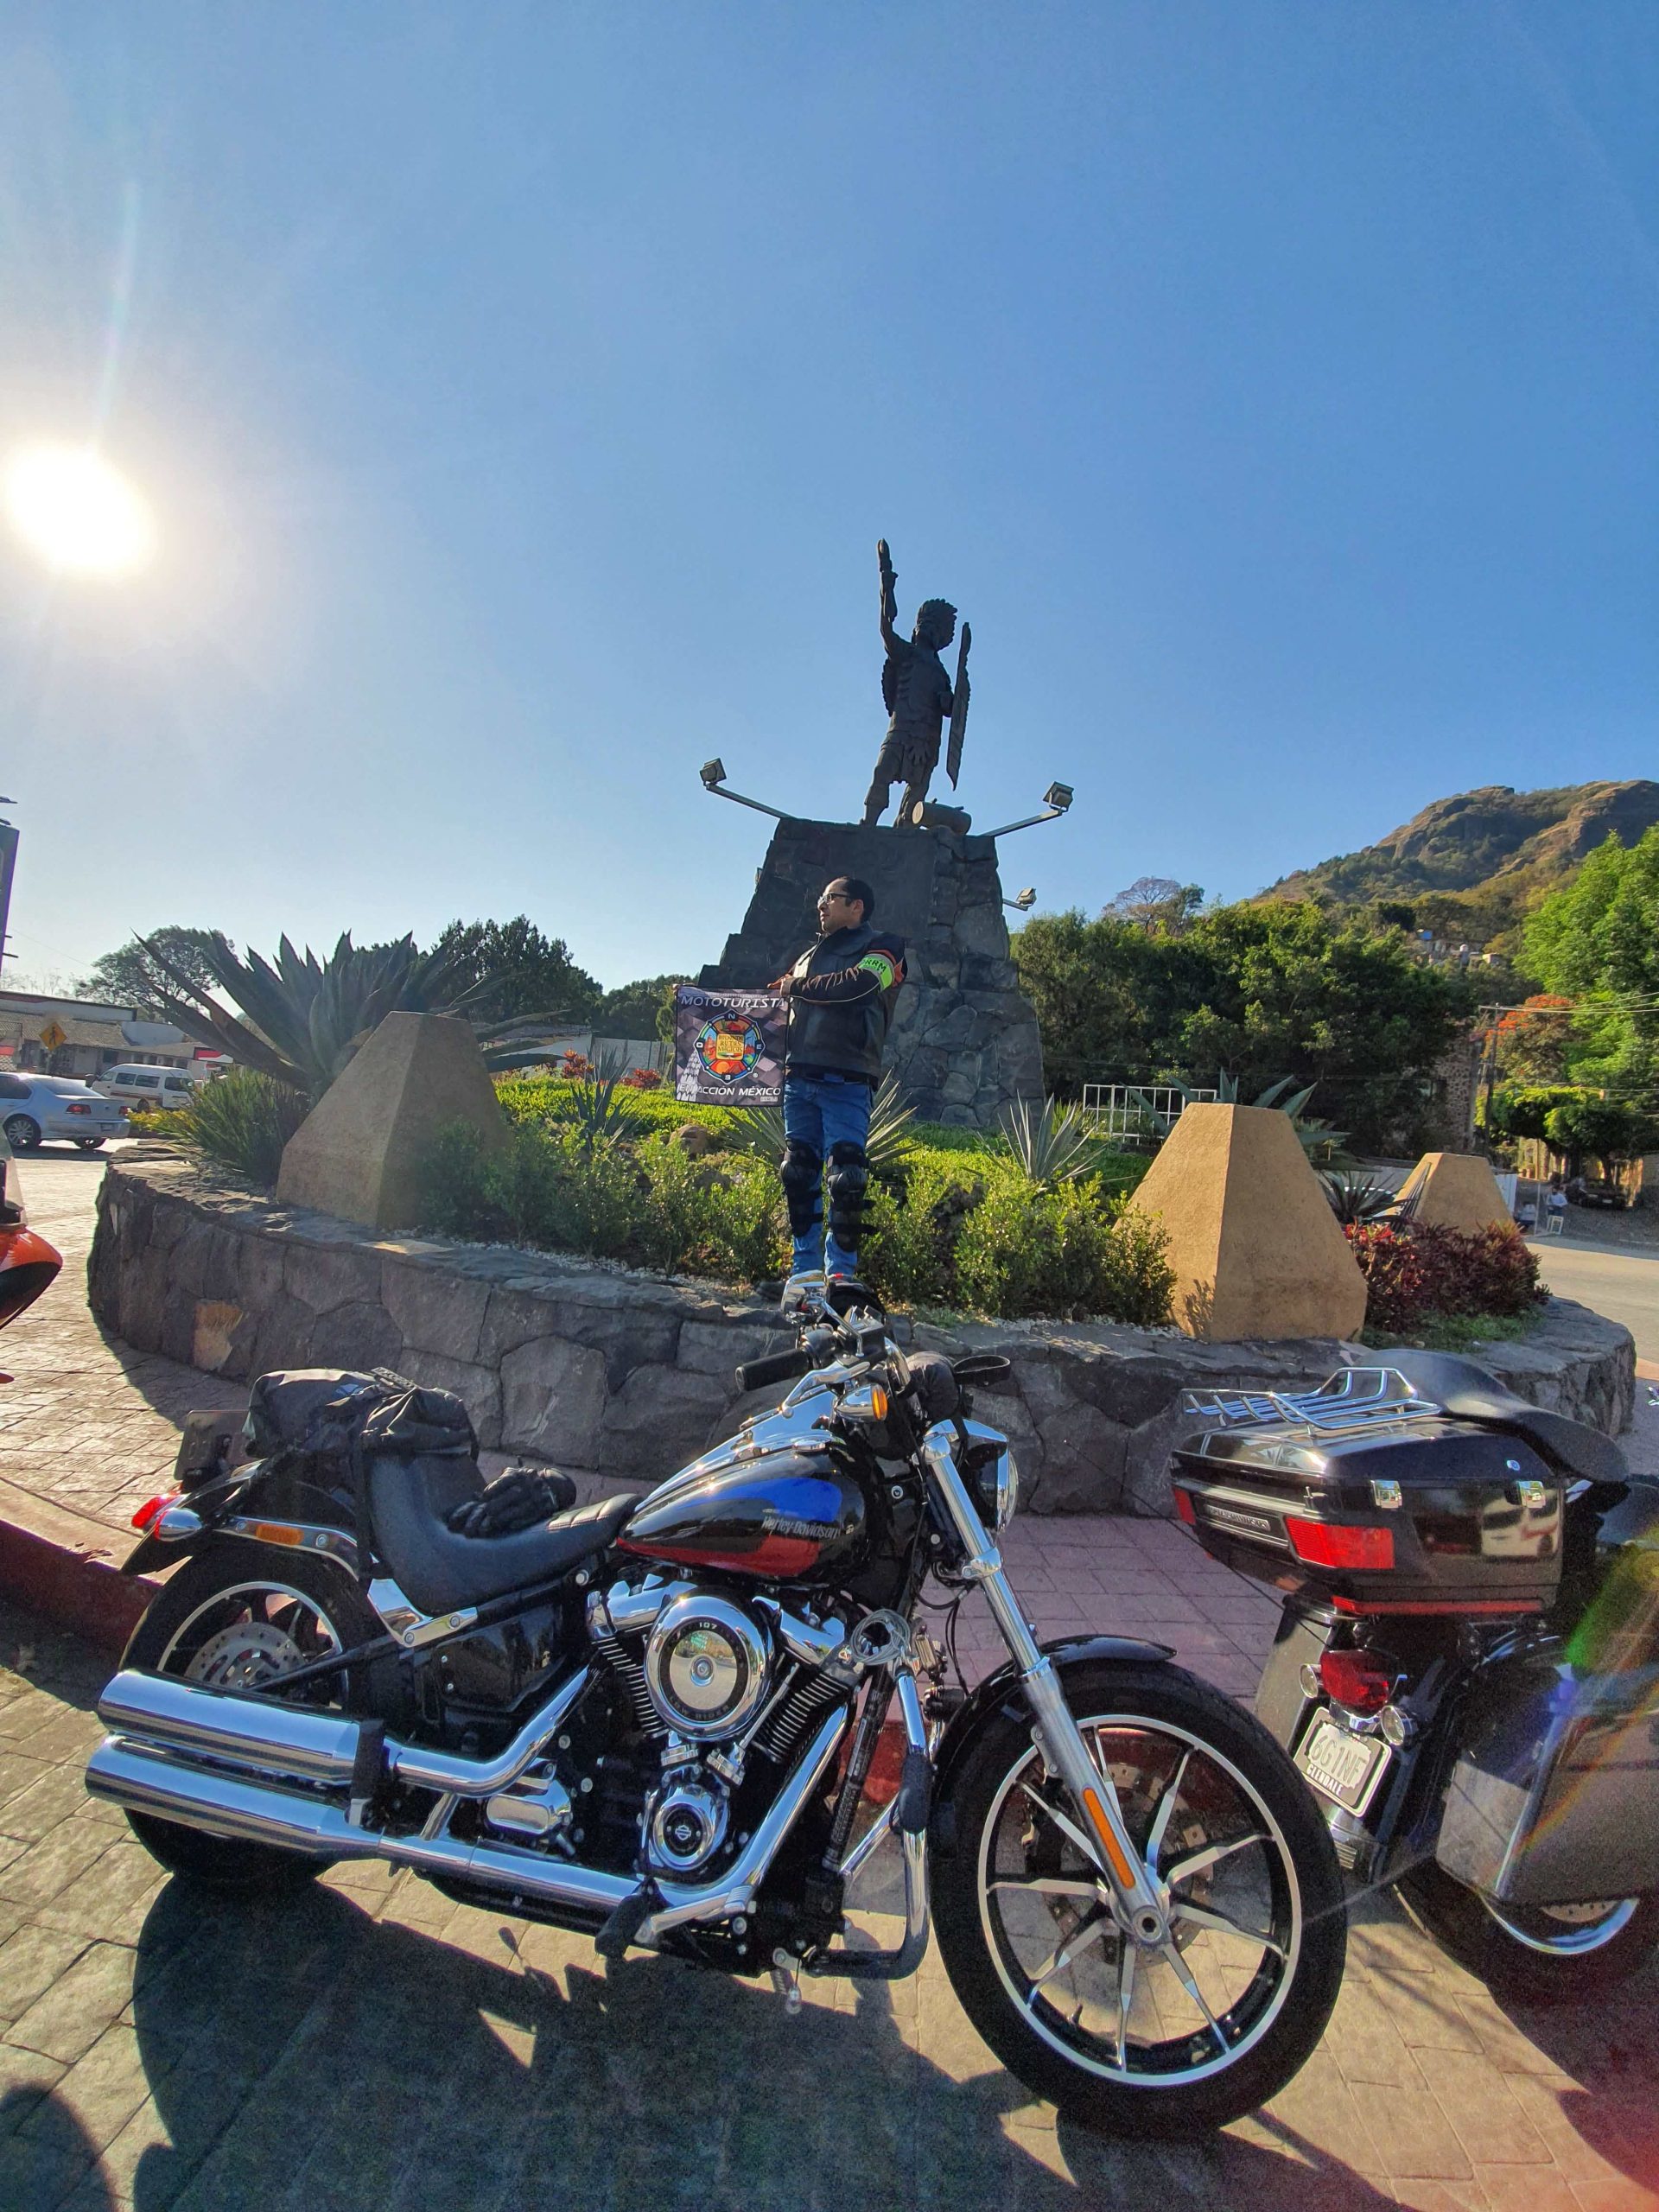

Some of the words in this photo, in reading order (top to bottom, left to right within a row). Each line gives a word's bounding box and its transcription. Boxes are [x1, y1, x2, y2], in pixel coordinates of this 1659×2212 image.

[681, 995, 785, 1009] MOTOTURISTA
[698, 1085, 735, 1096] ACCIÓN
[738, 1085, 781, 1096] MÉXICO
[761, 1516, 841, 1540] Harley-Davidson
[699, 1621, 717, 1630] 107
[1306, 1764, 1344, 1796] GLENDALE
